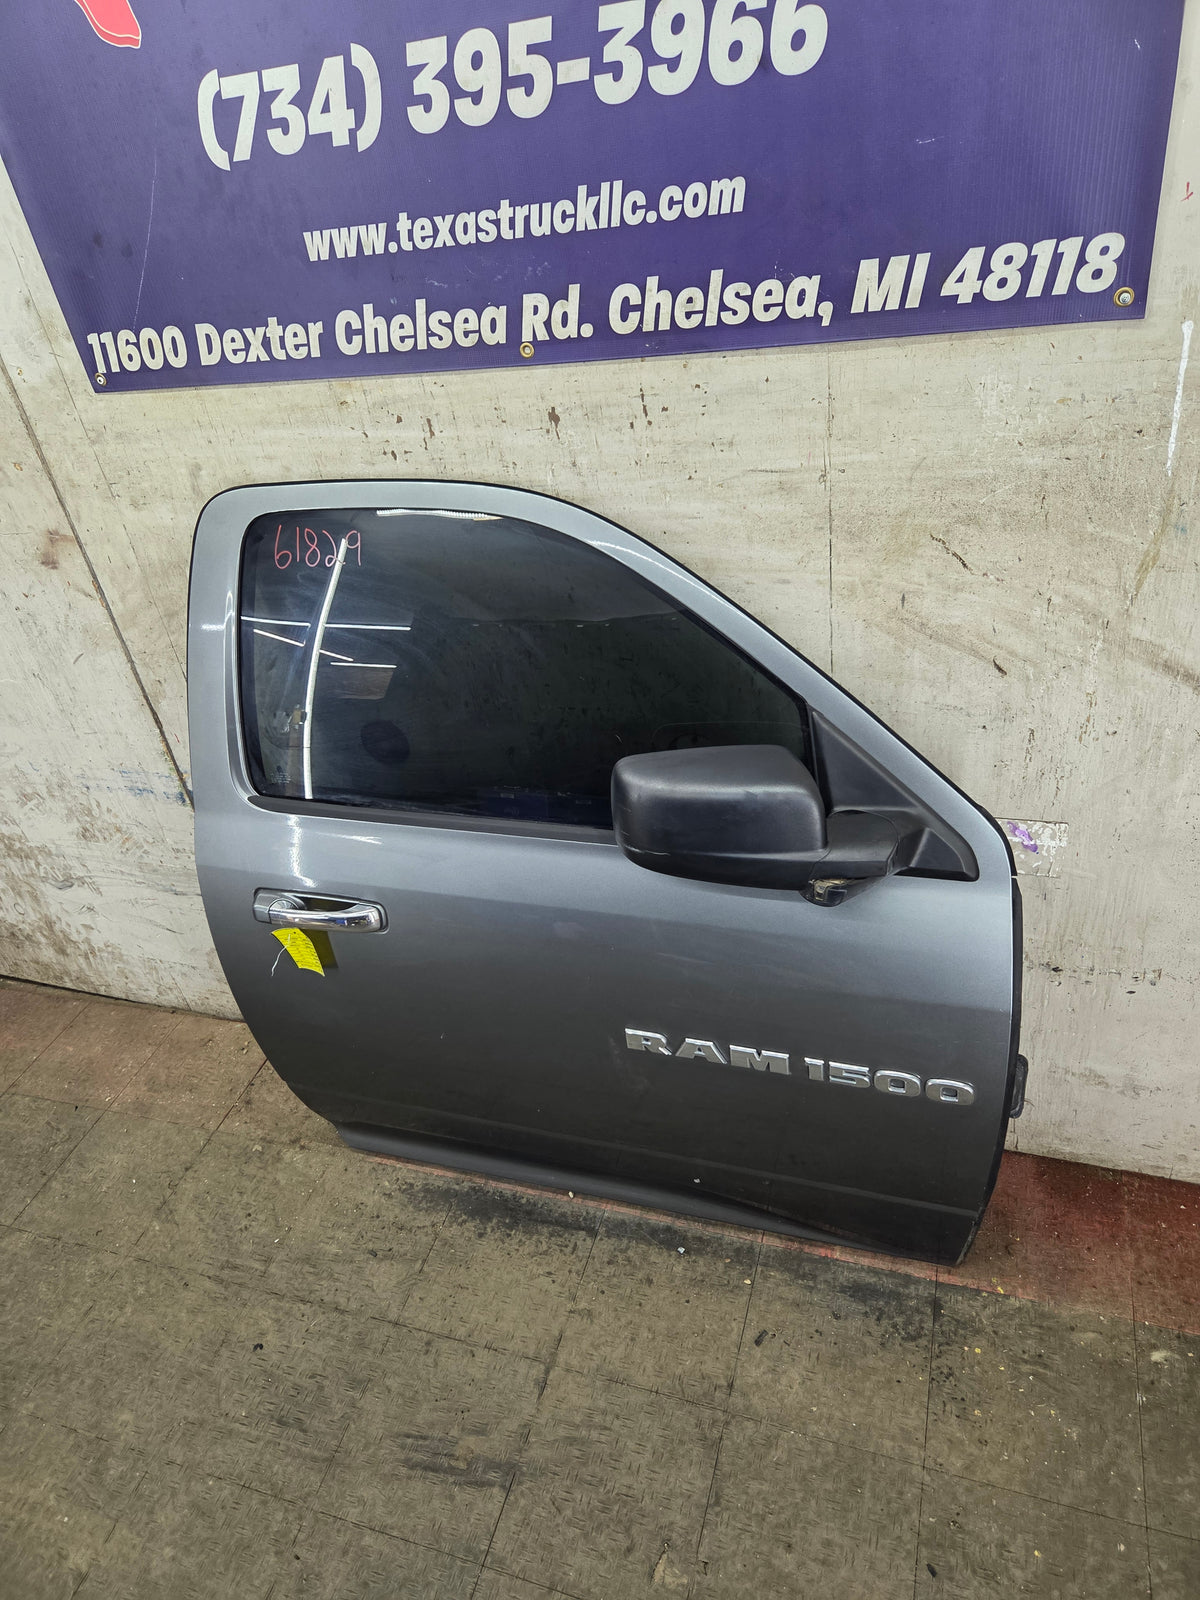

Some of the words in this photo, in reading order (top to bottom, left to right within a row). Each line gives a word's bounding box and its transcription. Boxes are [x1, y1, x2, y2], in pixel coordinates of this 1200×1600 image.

[196, 43, 383, 171] (734)
[405, 0, 829, 135] 395-3966
[302, 175, 746, 262] www.texastruckllc.com
[87, 325, 188, 374] 11600
[194, 316, 324, 366] Dexter
[334, 298, 507, 356] Chelsea
[521, 283, 594, 343] Rd.
[608, 268, 833, 335] Chelsea,
[850, 252, 931, 314] MI
[939, 231, 1126, 305] 48118
[274, 524, 361, 570] 61829
[624, 1027, 792, 1075] RAM
[804, 1056, 975, 1105] 1500
